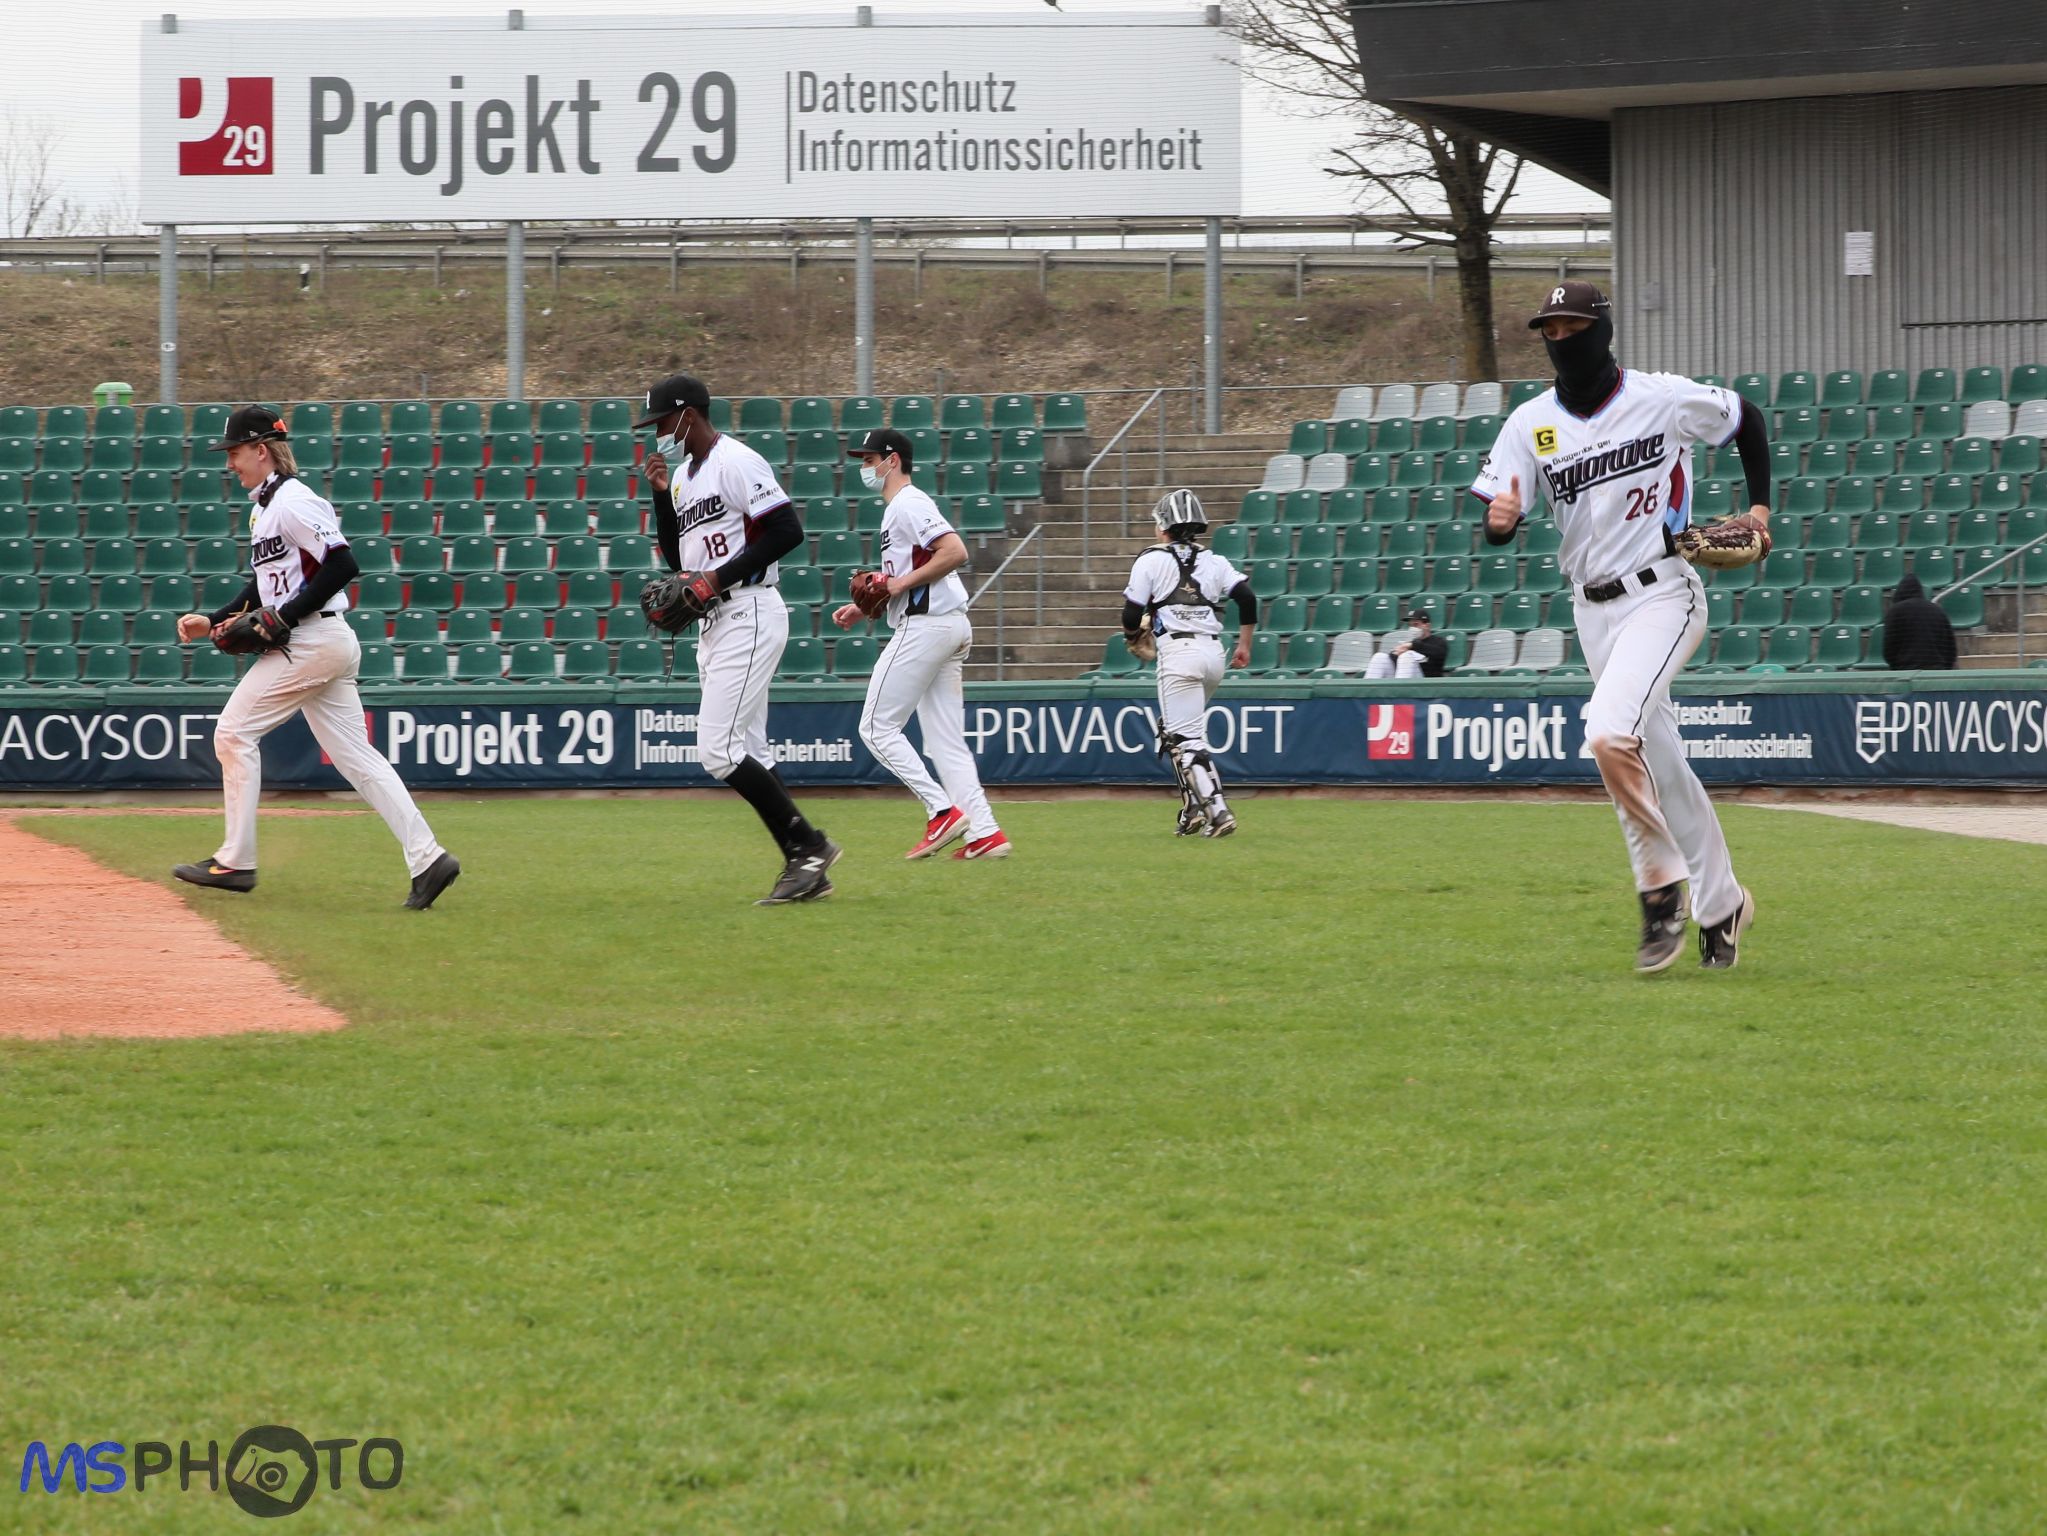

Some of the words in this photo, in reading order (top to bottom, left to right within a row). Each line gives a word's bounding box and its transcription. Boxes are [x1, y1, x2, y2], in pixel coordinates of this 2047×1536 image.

[799, 70, 1017, 113] Datenschutz
[223, 125, 267, 168] 29
[309, 75, 601, 196] Projekt
[637, 71, 738, 174] 29
[799, 128, 1203, 171] Informationssicherheit
[1625, 481, 1660, 521] 26
[703, 532, 730, 560] 18
[269, 570, 290, 597] 21
[976, 705, 1295, 754] PRIVACYOFT
[1674, 700, 1753, 725] tenschutz
[1891, 700, 2047, 754] PRIVACYS
[388, 710, 543, 775] Projekt
[557, 709, 614, 765] 29
[1388, 732, 1409, 755] 29
[1427, 703, 1568, 772] Projekt
[1682, 733, 1813, 759] rmationssicherheit
